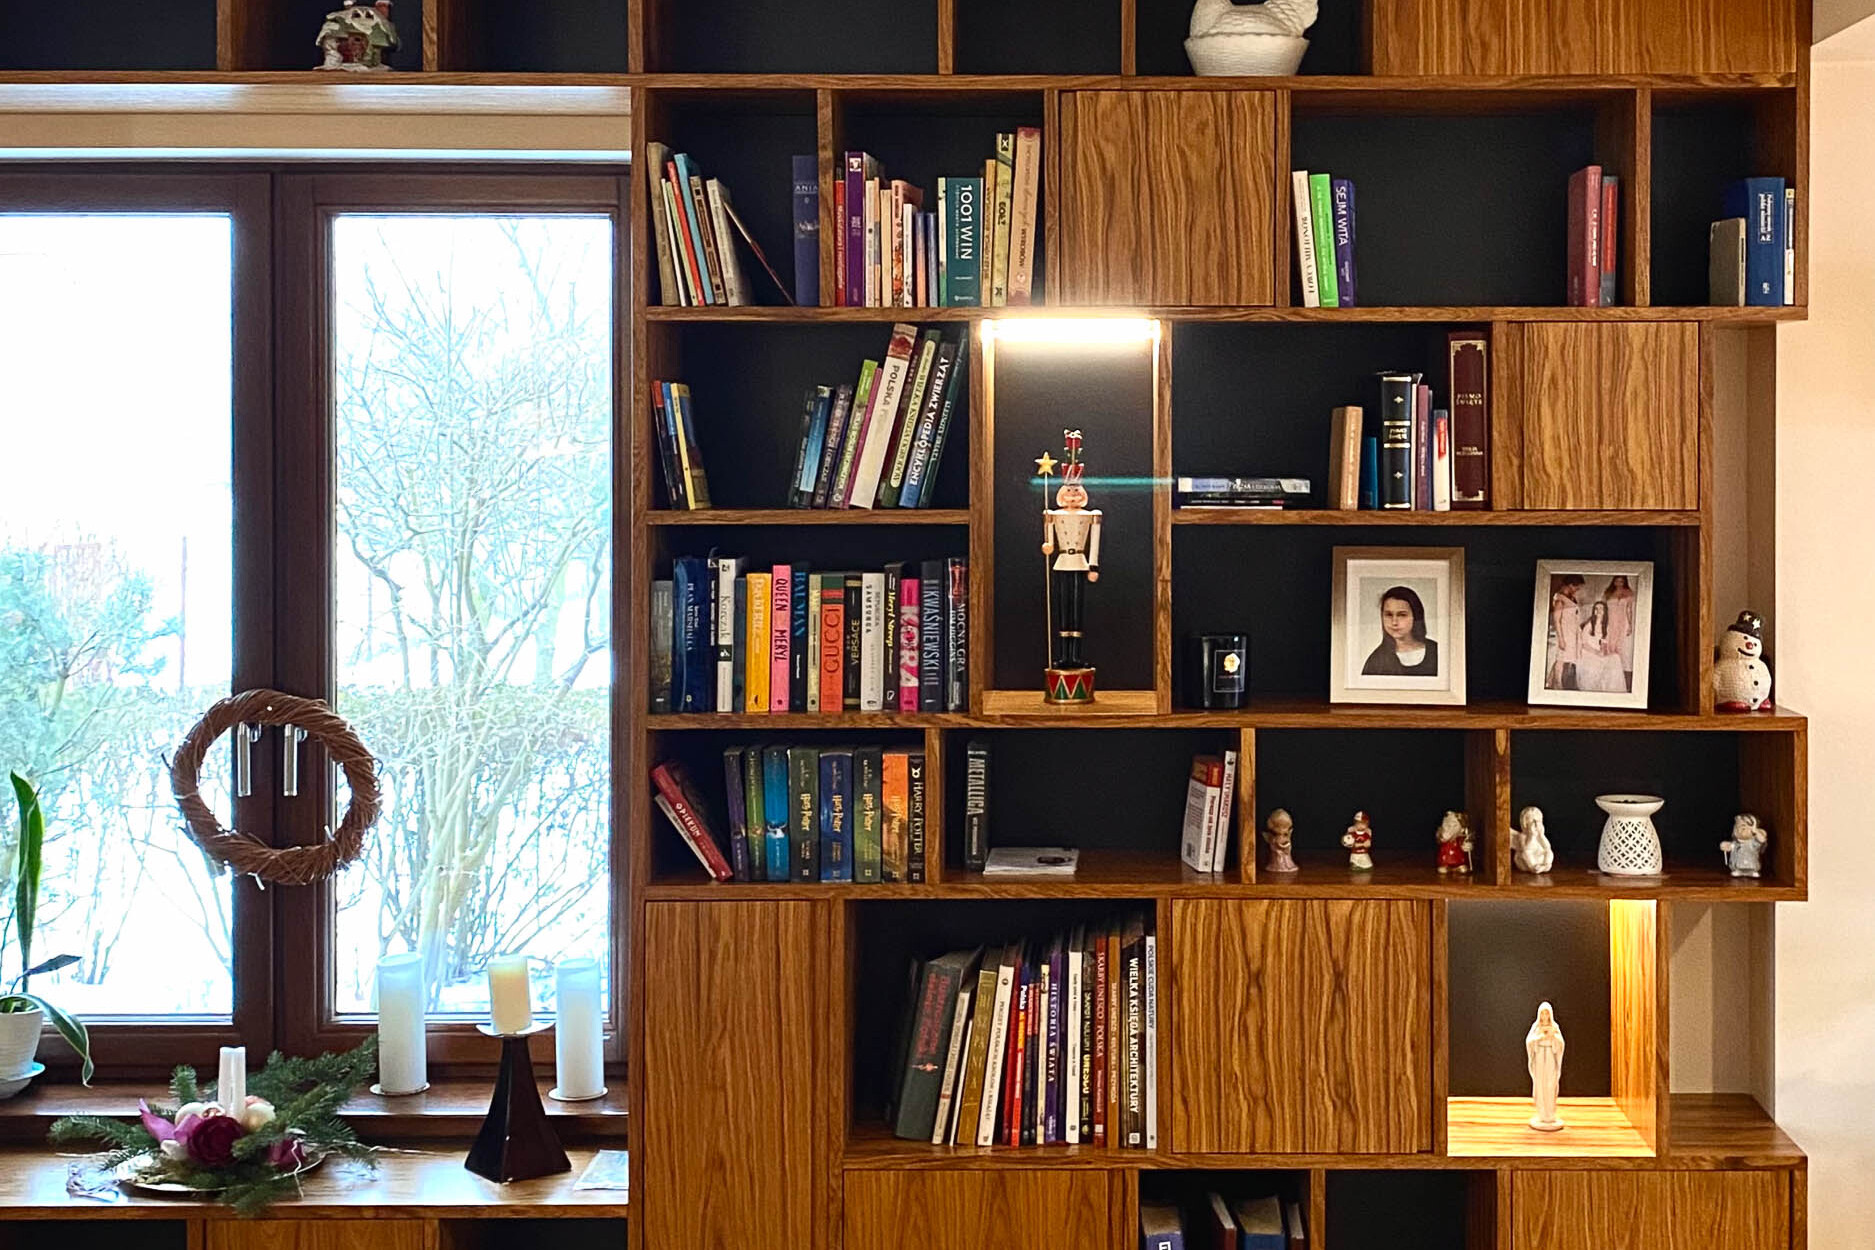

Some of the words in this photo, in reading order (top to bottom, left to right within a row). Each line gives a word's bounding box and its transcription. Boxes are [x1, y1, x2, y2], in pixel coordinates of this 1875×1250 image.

[961, 185, 973, 222] 1001
[1336, 186, 1347, 215] SEJM
[961, 225, 973, 259] WIN
[1338, 218, 1349, 246] WITA
[882, 364, 900, 406] POLSKA
[908, 410, 936, 485] ENCYKLOPEDIA
[928, 357, 950, 409] ZWIERZĄT
[775, 578, 789, 611] QUEEN
[793, 572, 806, 637] BAUMAN
[886, 592, 895, 617] Meryl
[720, 595, 731, 640] Korczak
[923, 591, 944, 670] KWAŚNIEWSKI
[957, 603, 966, 644] MOCNA
[774, 629, 788, 662] MERYL
[824, 608, 841, 673] GUCCI
[851, 618, 861, 665] VERSACE
[900, 606, 919, 687] KORA
[957, 648, 966, 672] GRA
[912, 782, 924, 816] HARRY
[968, 758, 985, 815] METALLICA
[673, 801, 702, 837] OPIEKUN
[912, 818, 924, 854] POTTER
[1096, 952, 1104, 982] SKARBY
[1129, 957, 1138, 997] WIELKA
[1147, 944, 1155, 975] POLSKIE
[1019, 985, 1028, 1009] Polska
[1096, 983, 1104, 1019] UNESCO
[1147, 976, 1155, 997] CUDA
[1049, 983, 1058, 1037] HISTORIA
[1127, 998, 1138, 1035] KSIĘGA
[1147, 998, 1155, 1028] NATURY
[1096, 1024, 1104, 1057] POLSKA
[1048, 1042, 1057, 1082] ŚWIATA
[1082, 1054, 1090, 1093] UNESCO
[1129, 1036, 1139, 1112] ARCHITEKTURY
